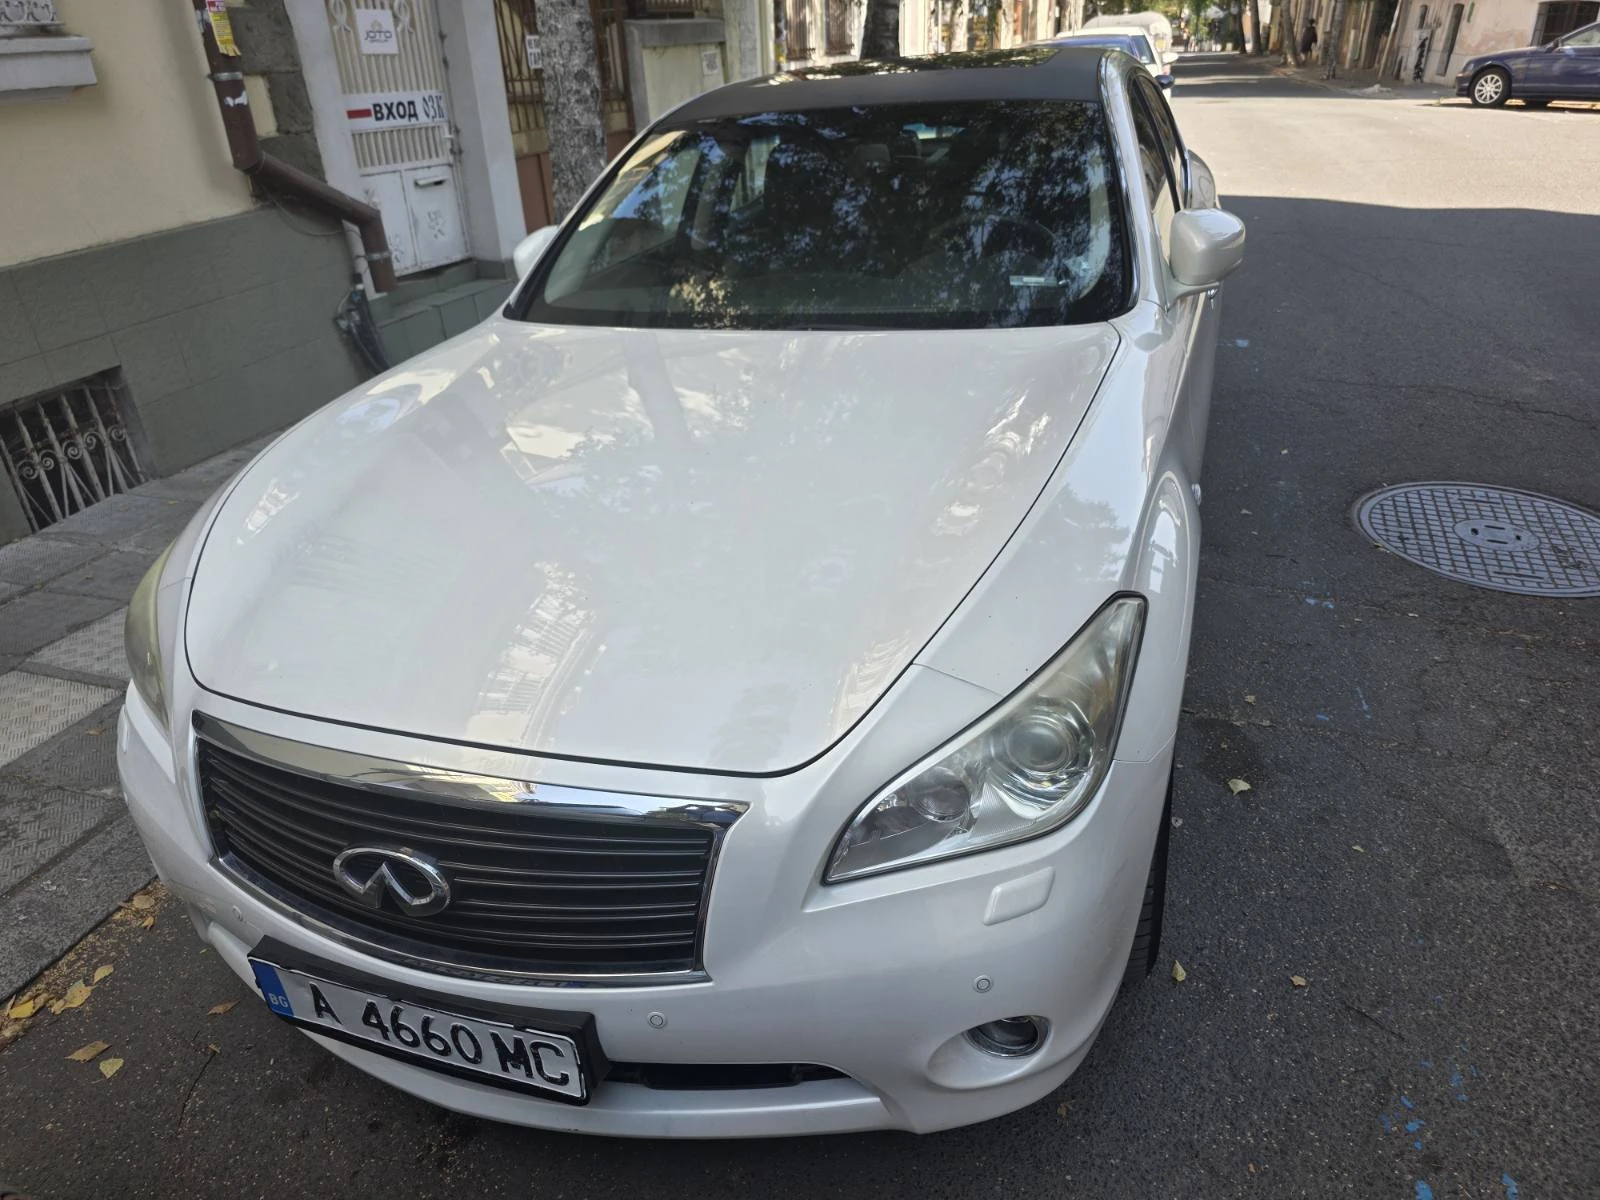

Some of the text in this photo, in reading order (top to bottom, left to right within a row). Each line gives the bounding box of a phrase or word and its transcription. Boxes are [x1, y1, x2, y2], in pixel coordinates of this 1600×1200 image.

[372, 100, 419, 122] ВХОД
[267, 992, 289, 1008] BG
[309, 982, 570, 1086] A 4660 MC
